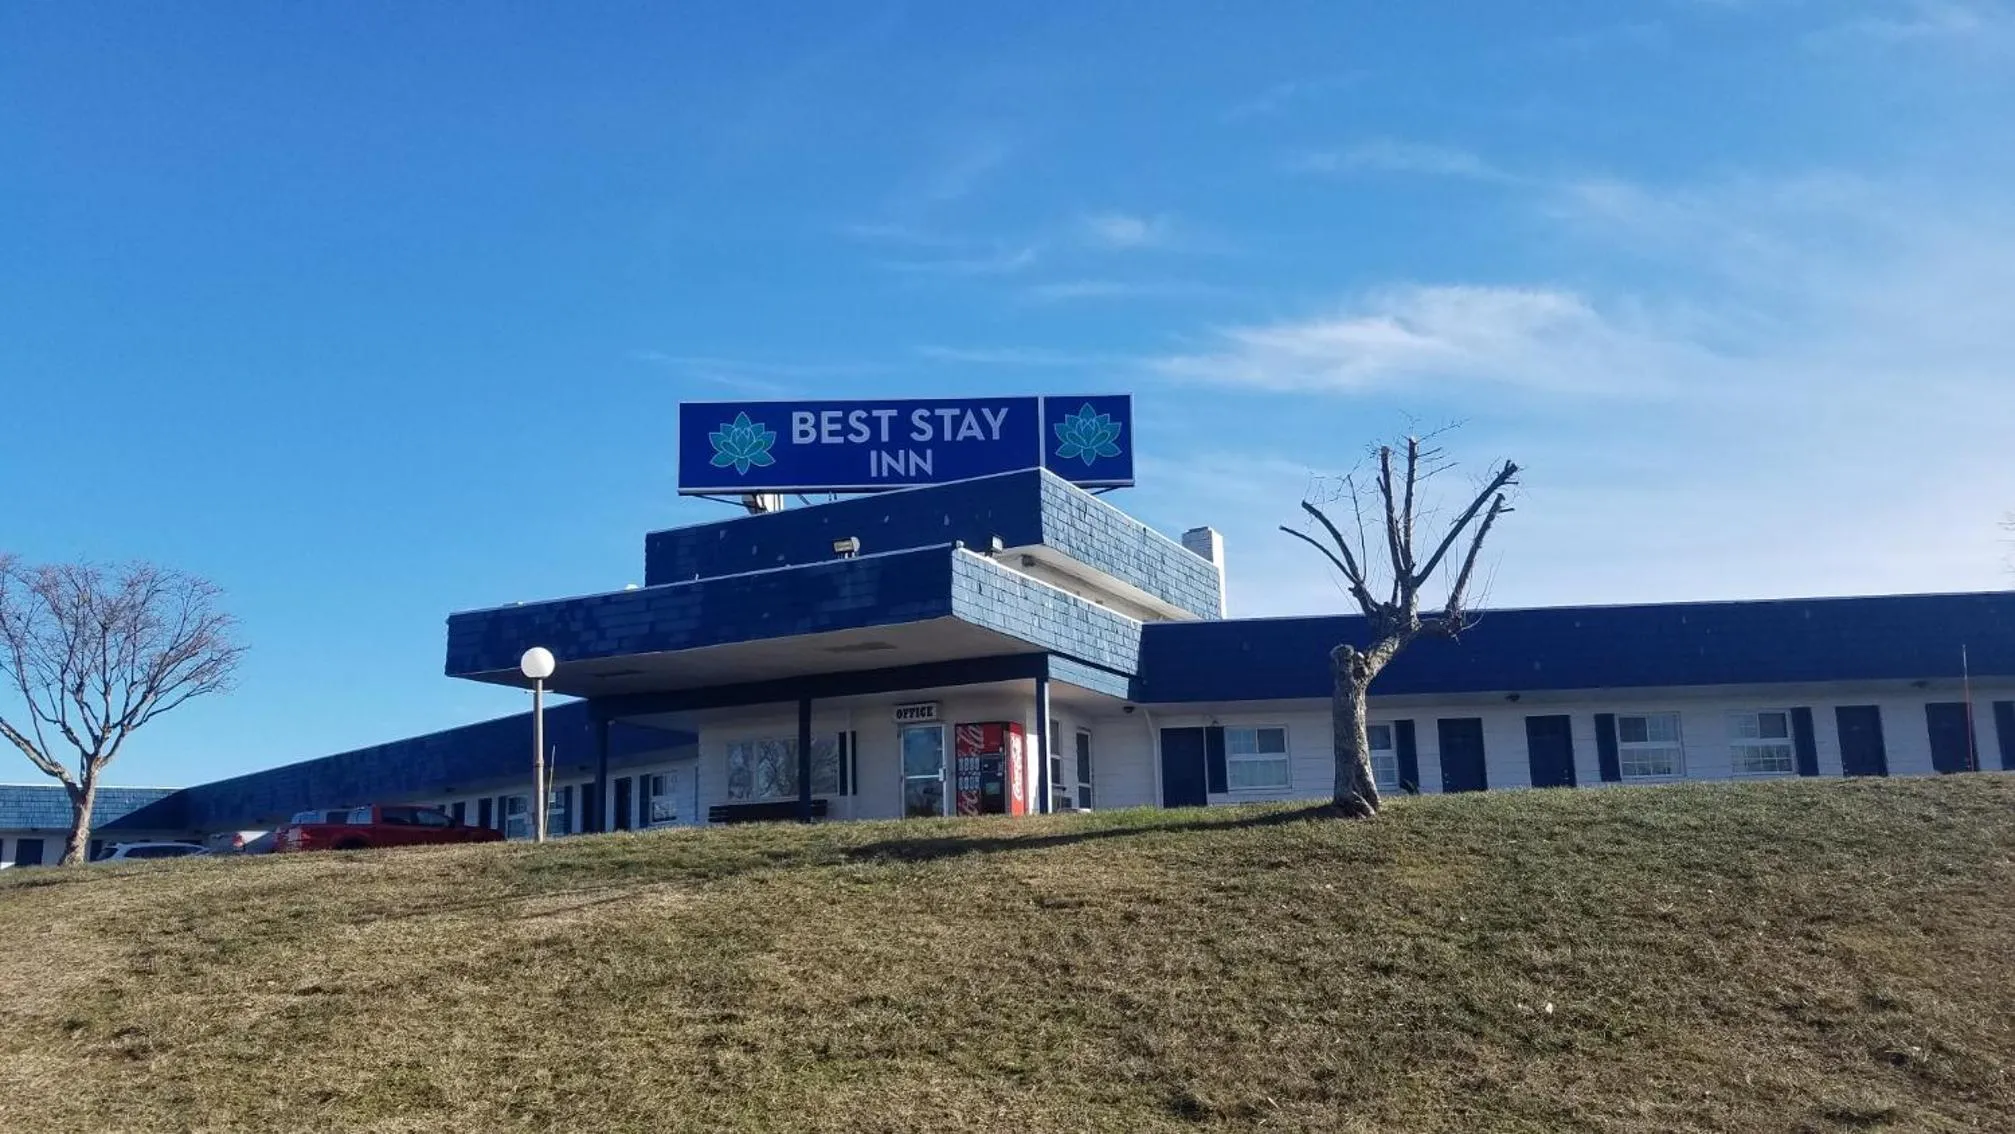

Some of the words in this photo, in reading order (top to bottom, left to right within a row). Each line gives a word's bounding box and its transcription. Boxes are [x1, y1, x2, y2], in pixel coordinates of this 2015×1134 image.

[792, 409, 898, 444] BEST
[910, 407, 1009, 441] STAY
[870, 448, 932, 477] INN
[896, 706, 933, 720] OFFICE
